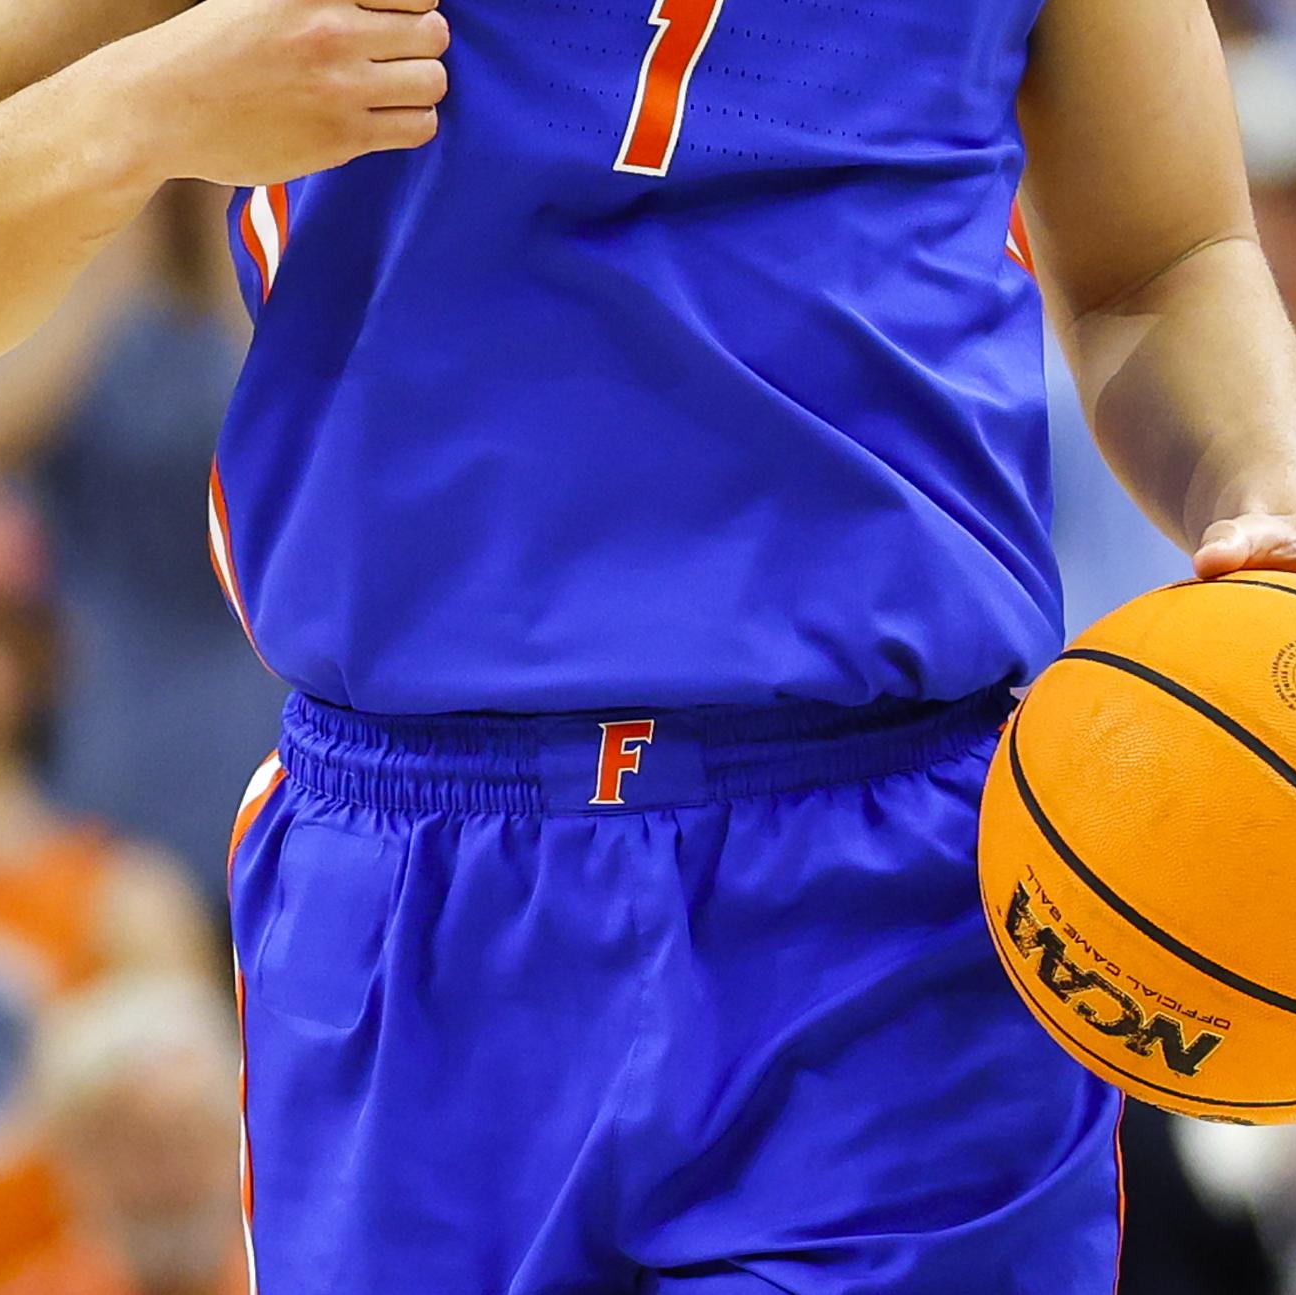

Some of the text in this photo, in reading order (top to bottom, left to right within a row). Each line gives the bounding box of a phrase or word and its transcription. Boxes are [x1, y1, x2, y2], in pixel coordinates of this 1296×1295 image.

[588, 718, 655, 805] F
[1005, 880, 1226, 1078] NCAA
[1025, 863, 1232, 1031] OFFICIAL GAME BALL
